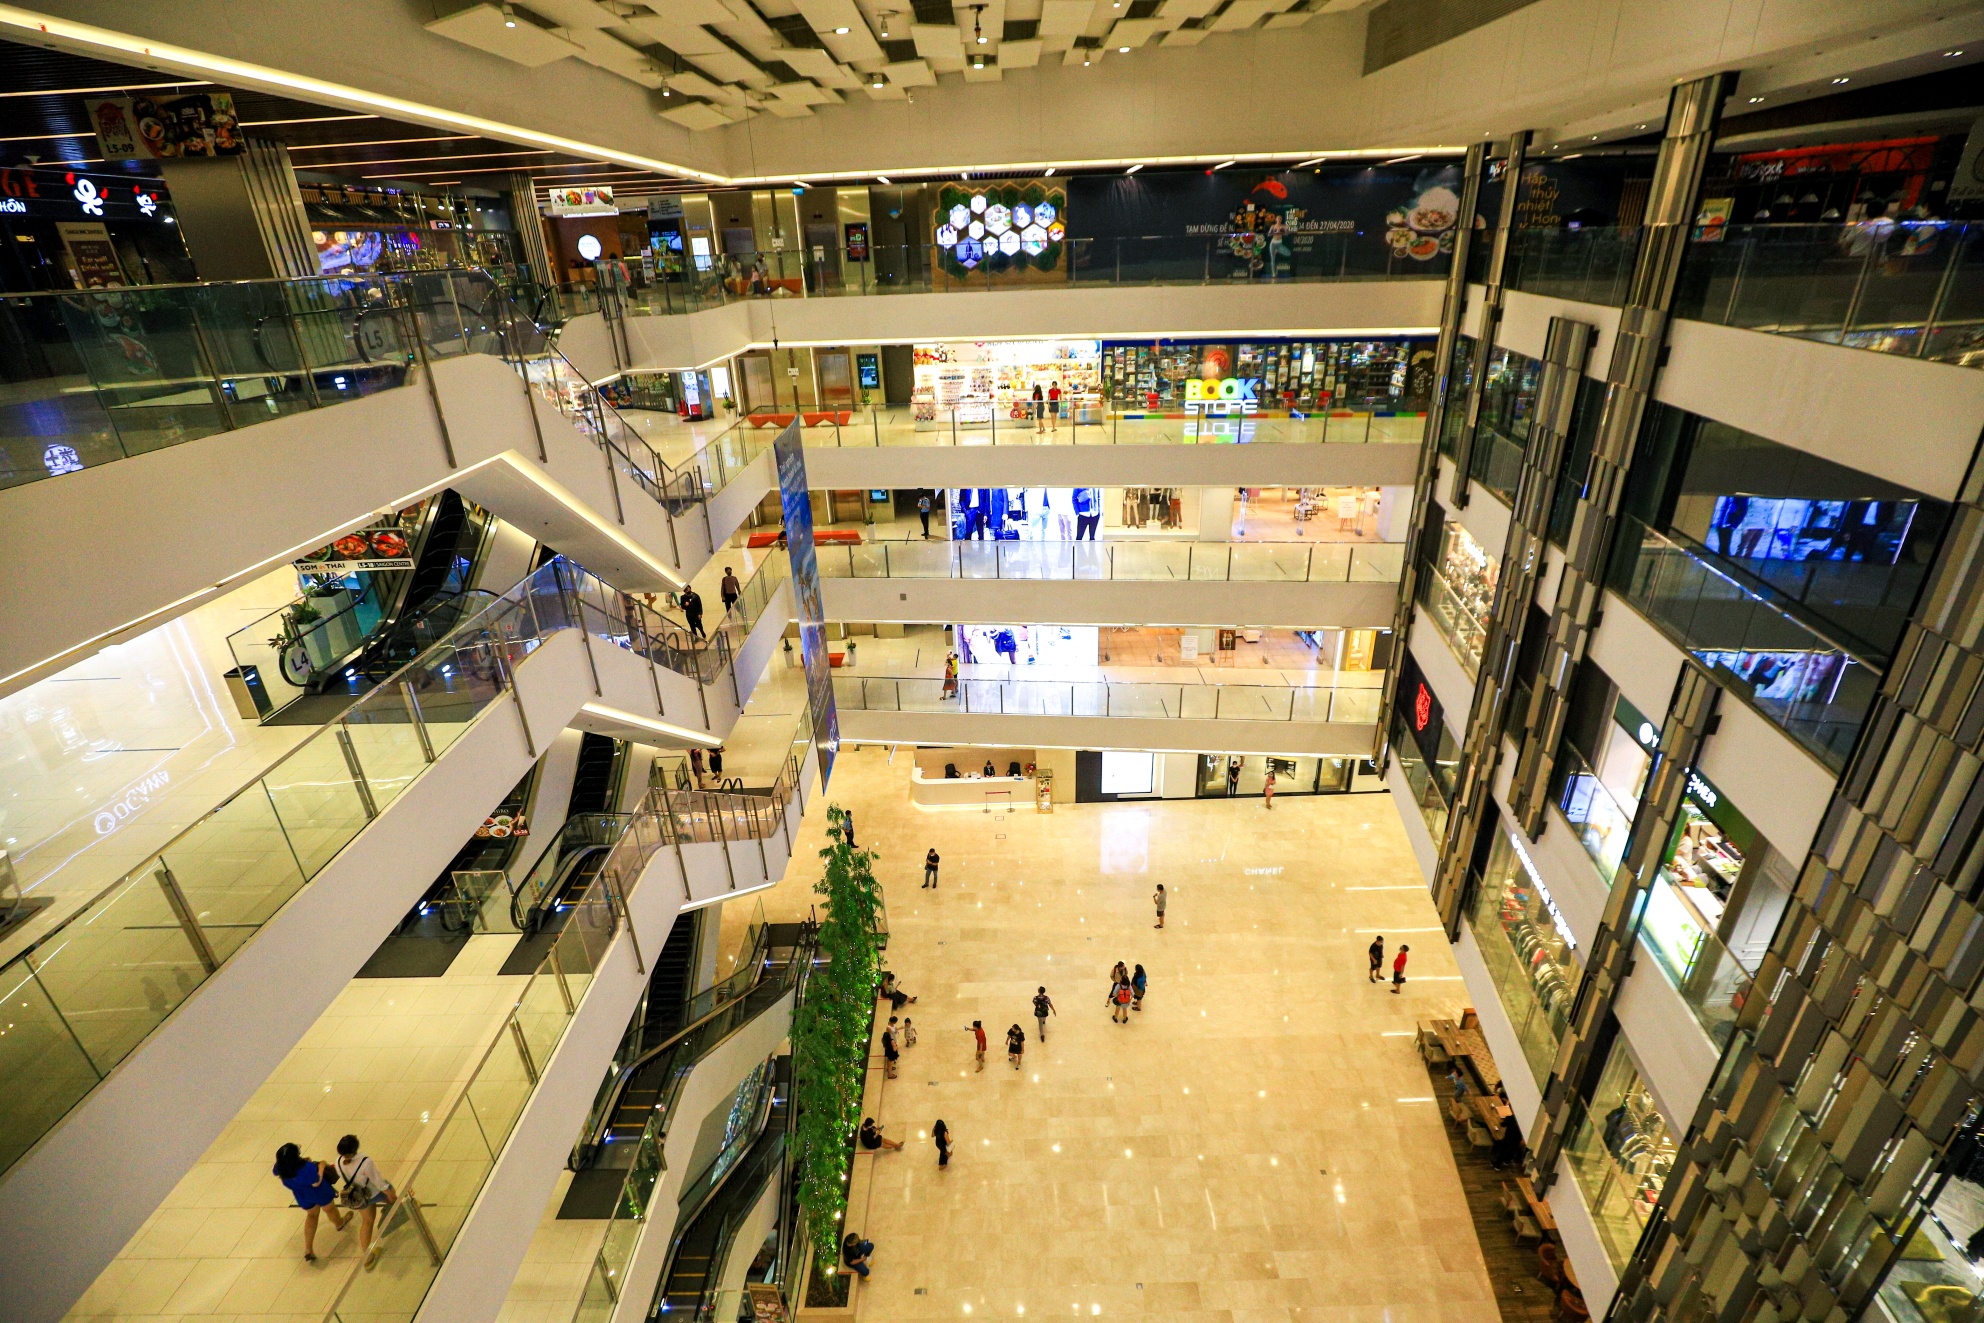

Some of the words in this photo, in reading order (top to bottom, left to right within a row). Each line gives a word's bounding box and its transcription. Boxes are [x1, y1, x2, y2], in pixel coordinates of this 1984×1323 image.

[1320, 221, 1355, 230] 27/04/2020
[364, 329, 384, 350] L5
[1185, 378, 1259, 400] BOOK
[290, 652, 309, 673] L4
